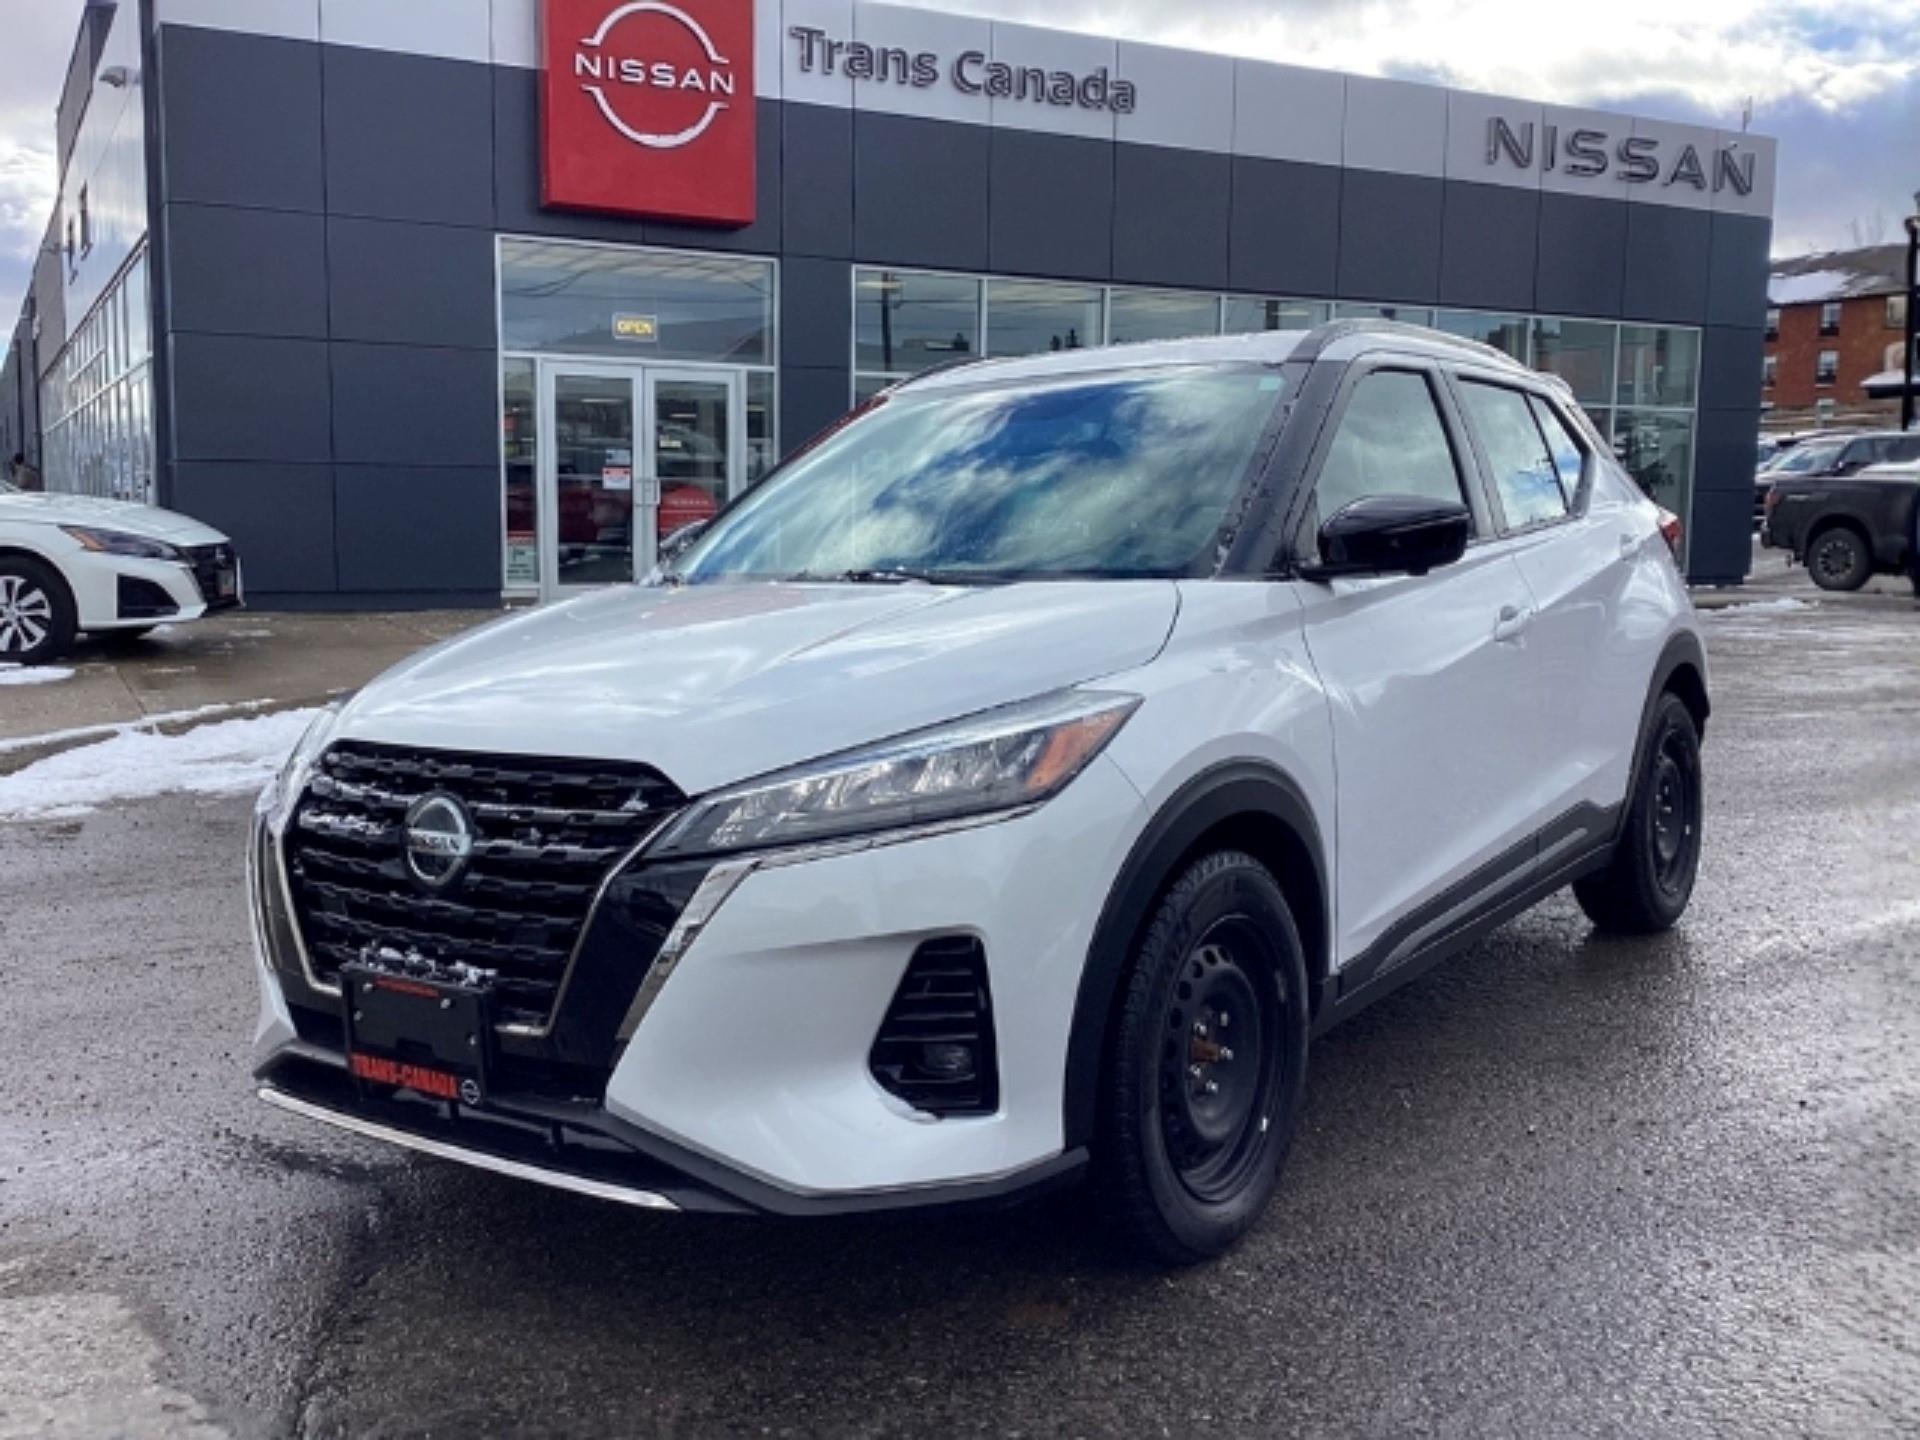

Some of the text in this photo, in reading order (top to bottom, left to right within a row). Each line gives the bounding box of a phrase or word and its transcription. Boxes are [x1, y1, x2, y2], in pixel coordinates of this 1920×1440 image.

[575, 51, 734, 95] NISSAN
[790, 24, 1137, 115] Trans Canada
[1486, 116, 1756, 197] NISSAN
[617, 319, 652, 334] OPEN
